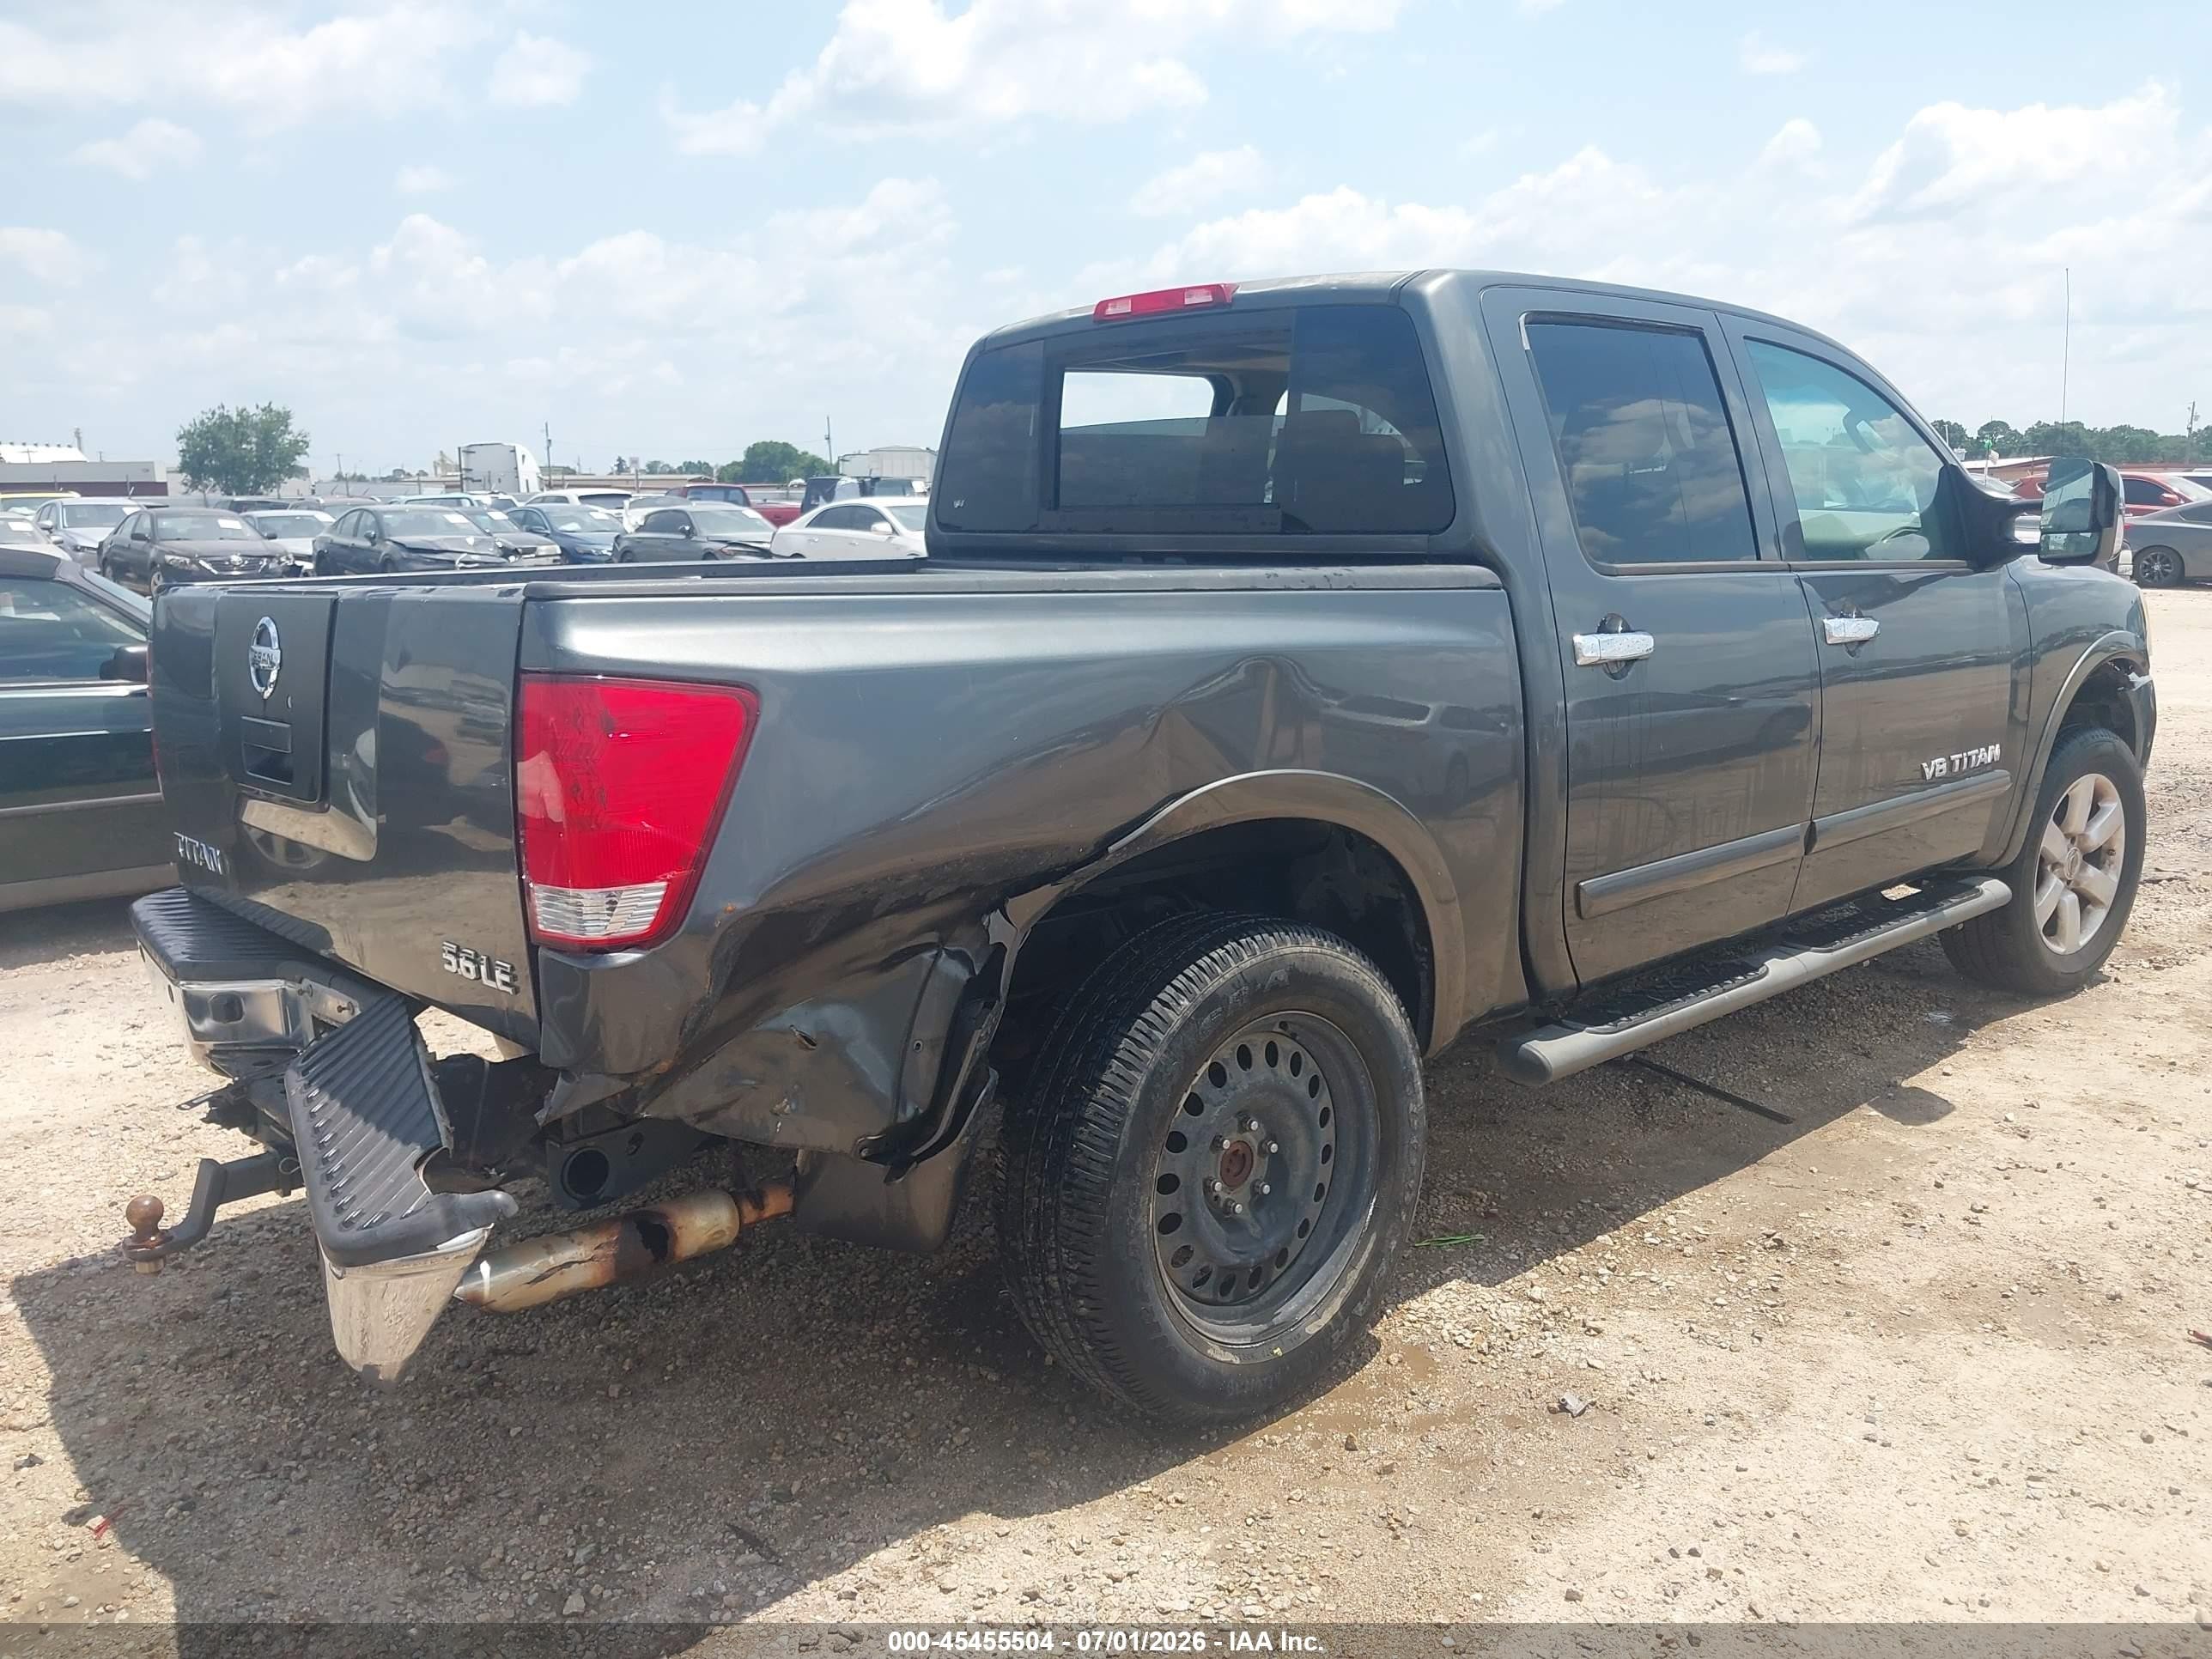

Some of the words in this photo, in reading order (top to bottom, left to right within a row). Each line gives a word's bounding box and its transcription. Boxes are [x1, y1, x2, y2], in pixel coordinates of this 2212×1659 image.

[1920, 757, 1948, 781] V8
[1949, 743, 2001, 773] TITAN
[173, 831, 222, 875] TITAN
